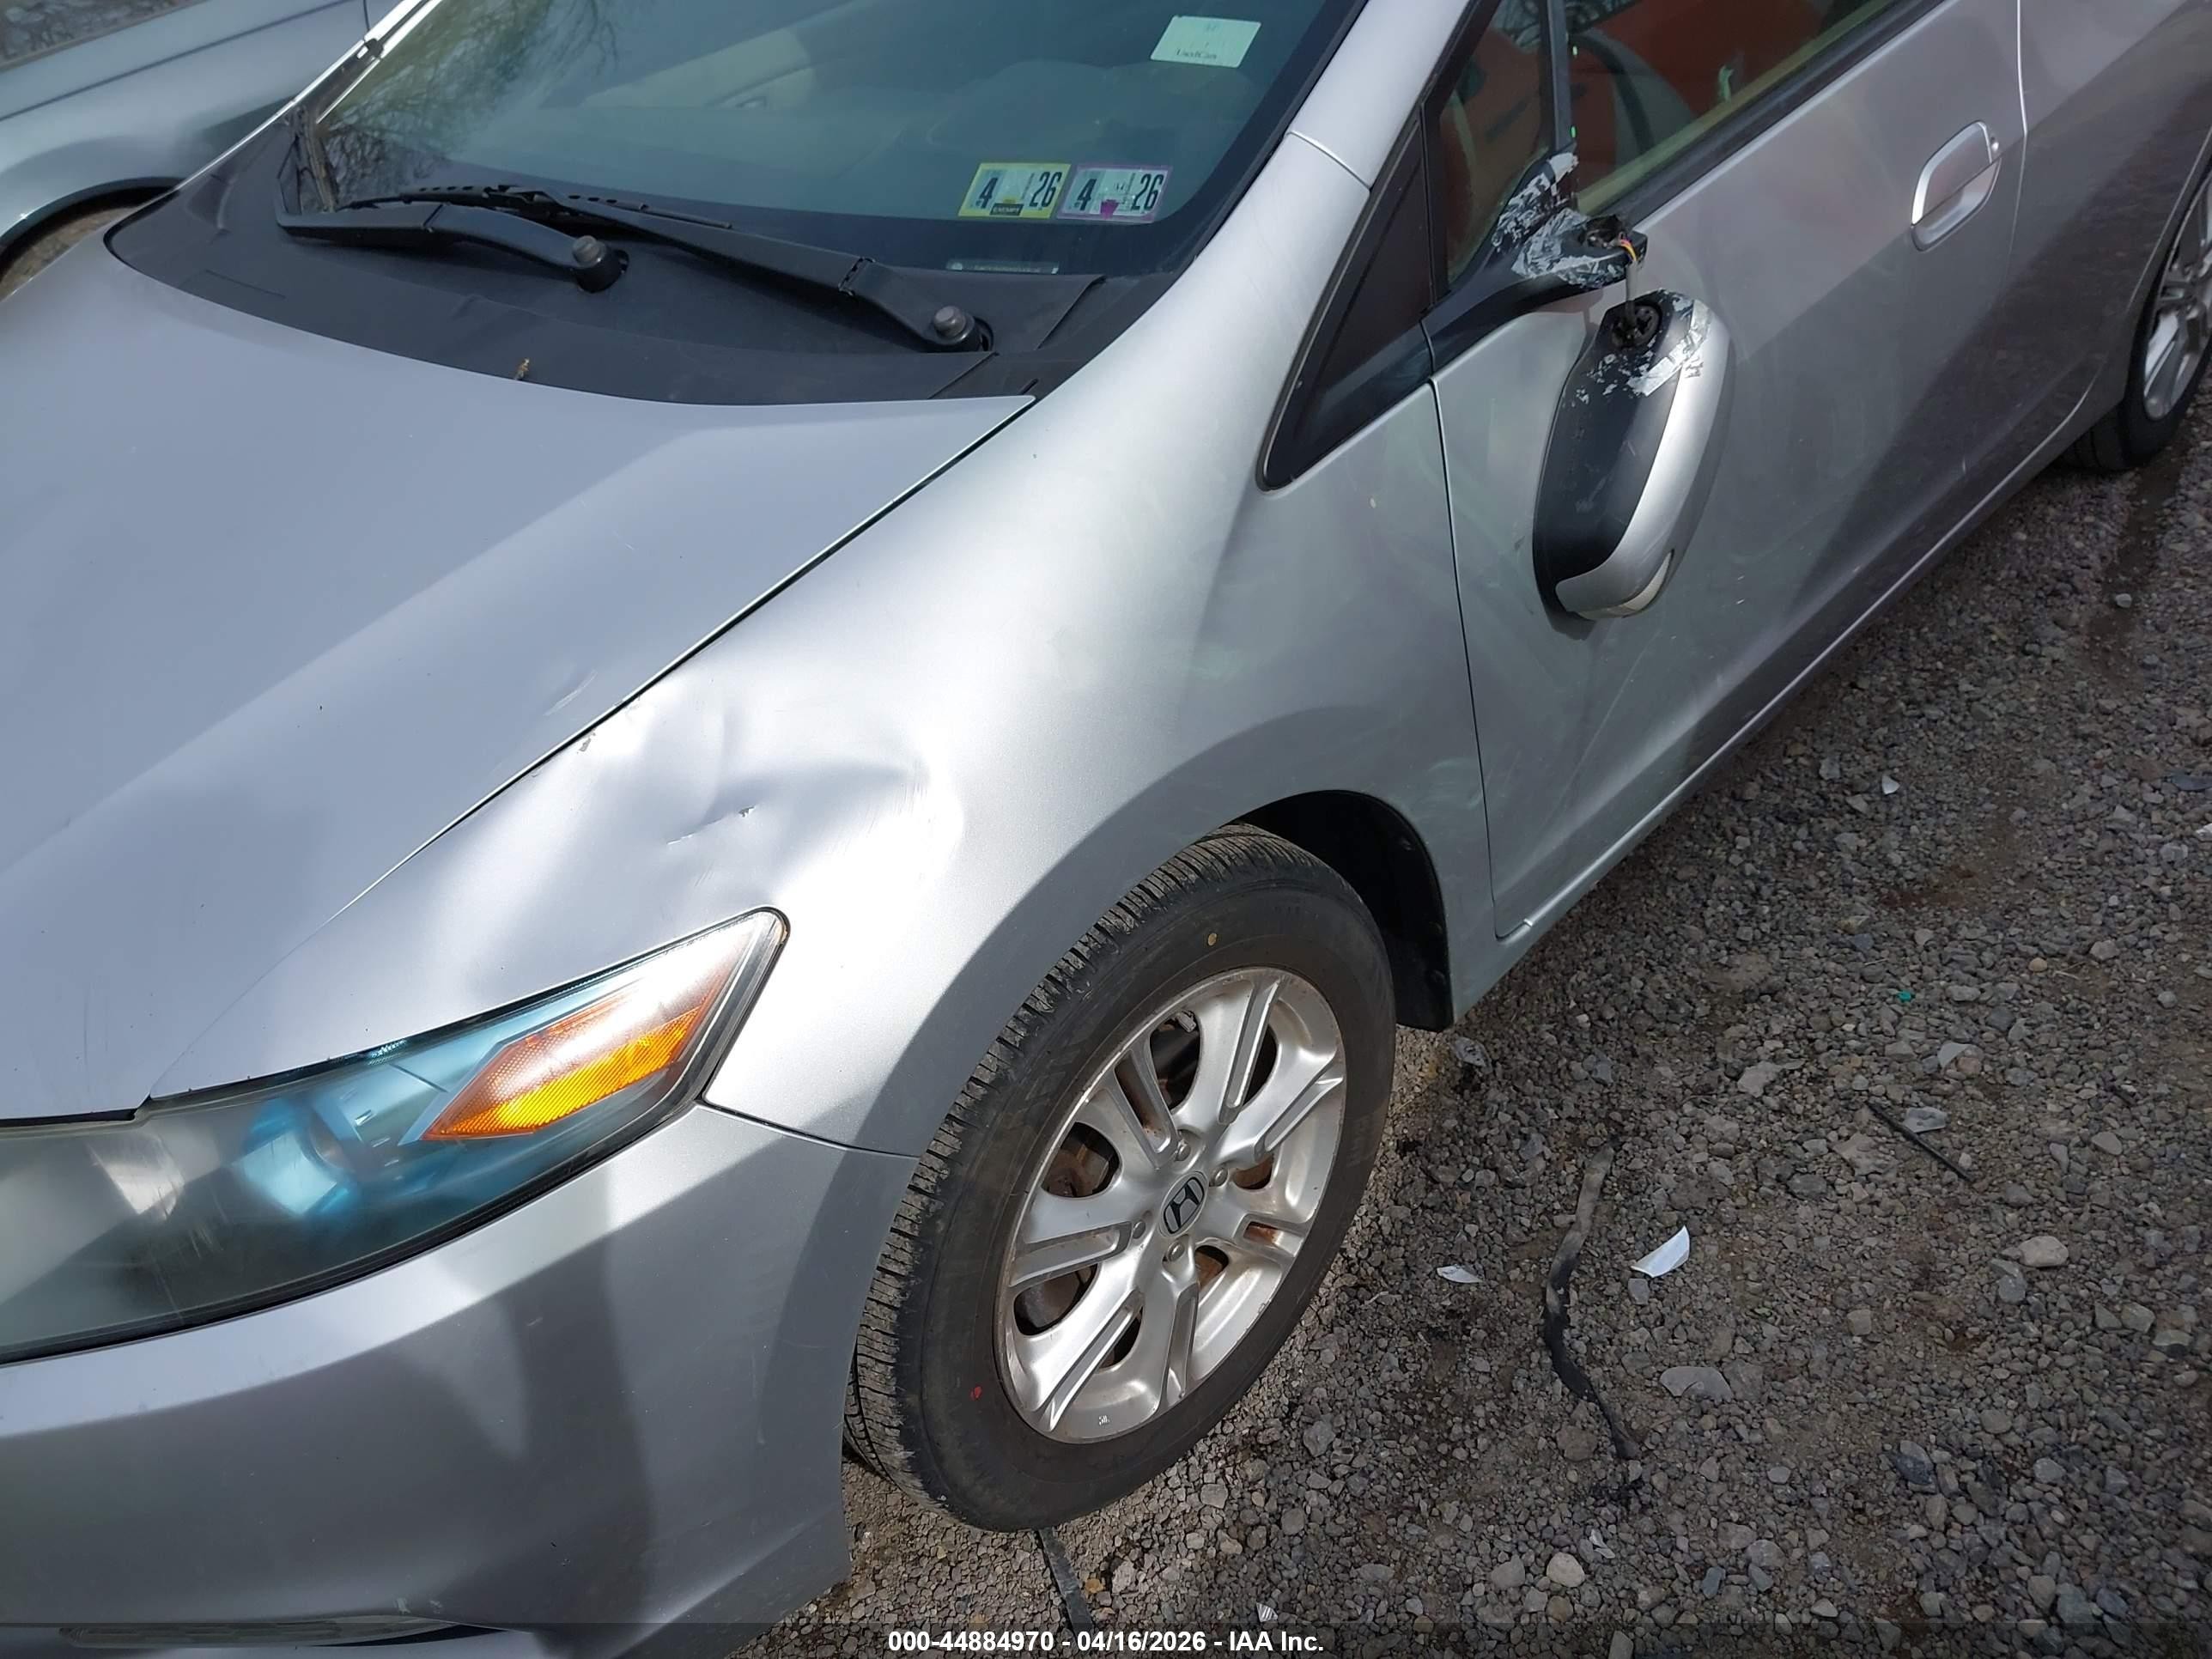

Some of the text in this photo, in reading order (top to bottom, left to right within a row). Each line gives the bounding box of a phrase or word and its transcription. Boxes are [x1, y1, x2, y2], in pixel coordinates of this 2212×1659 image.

[979, 177, 999, 210] 4
[1029, 171, 1062, 208] 26
[1078, 178, 1097, 211] 4
[1131, 173, 1164, 210] 26
